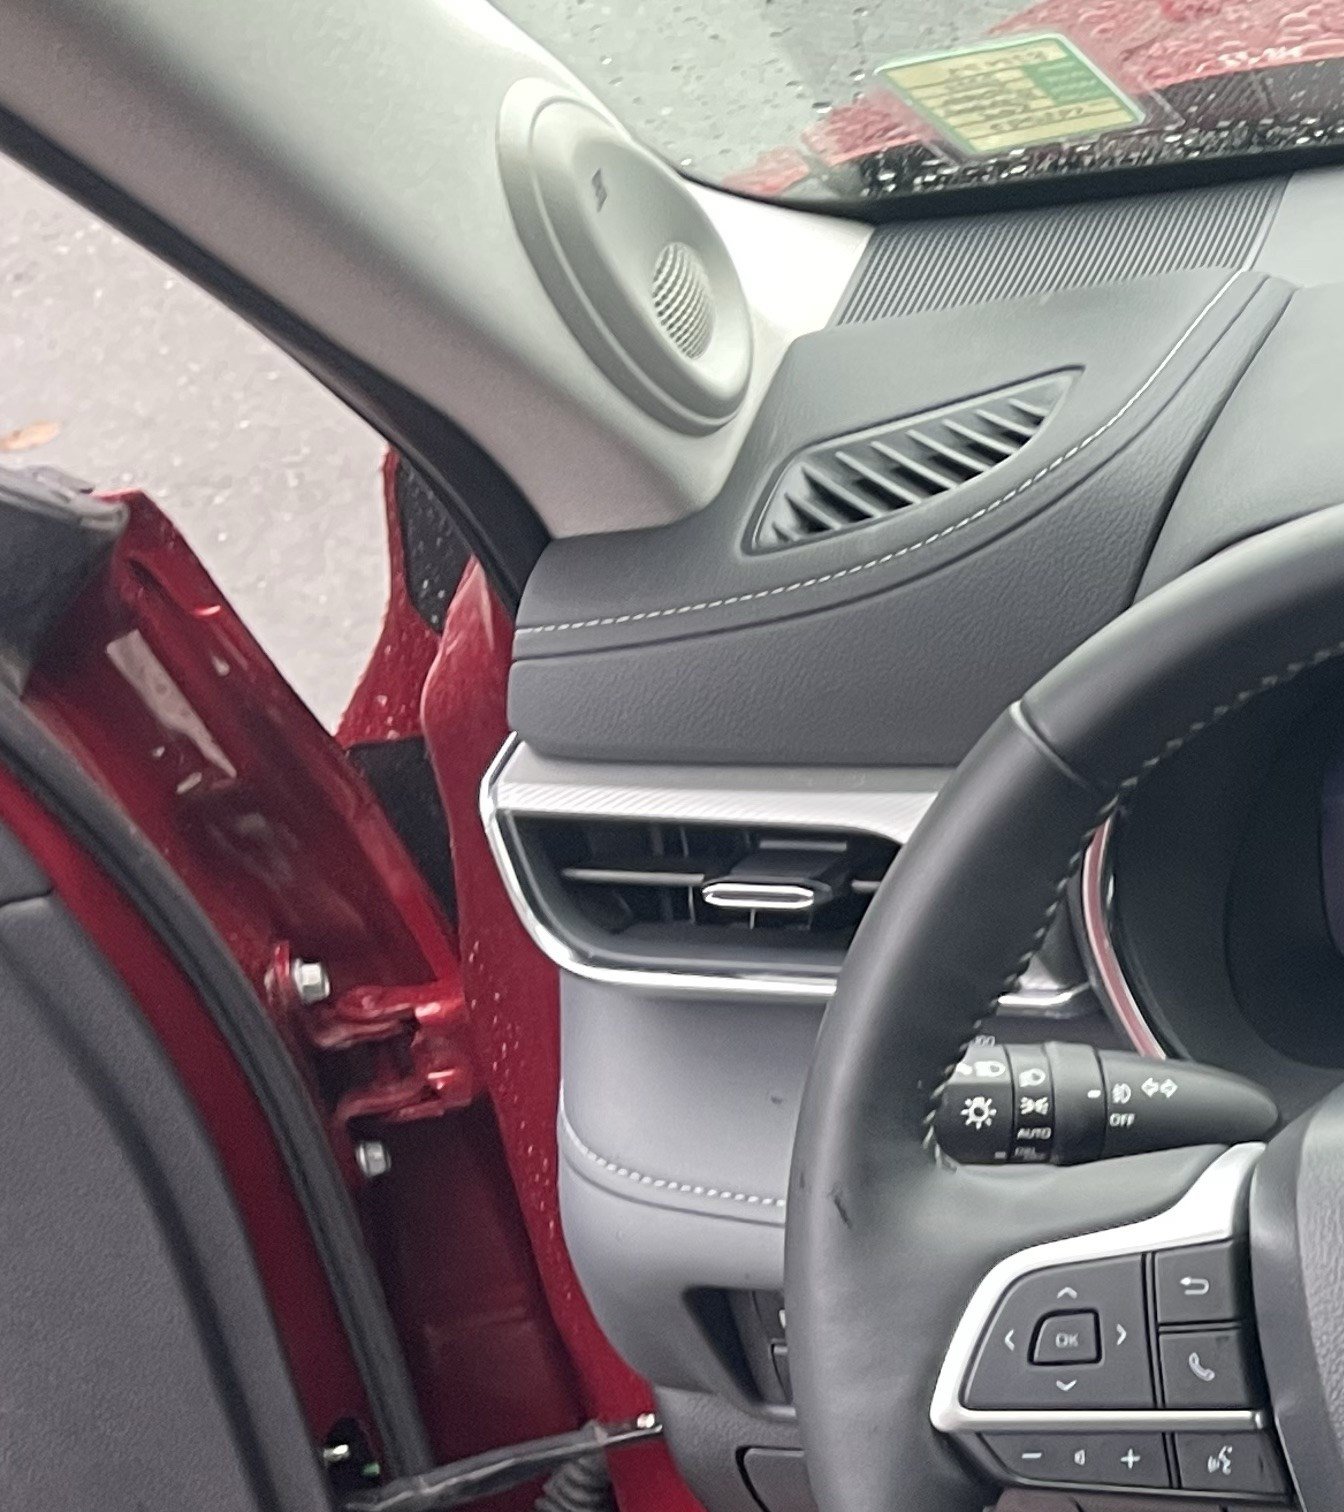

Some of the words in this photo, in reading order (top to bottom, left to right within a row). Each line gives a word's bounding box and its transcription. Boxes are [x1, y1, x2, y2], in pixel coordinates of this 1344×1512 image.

[1109, 1113, 1136, 1127] OFF
[1017, 1127, 1052, 1140] AUTO
[1055, 1333, 1080, 1348] OK
